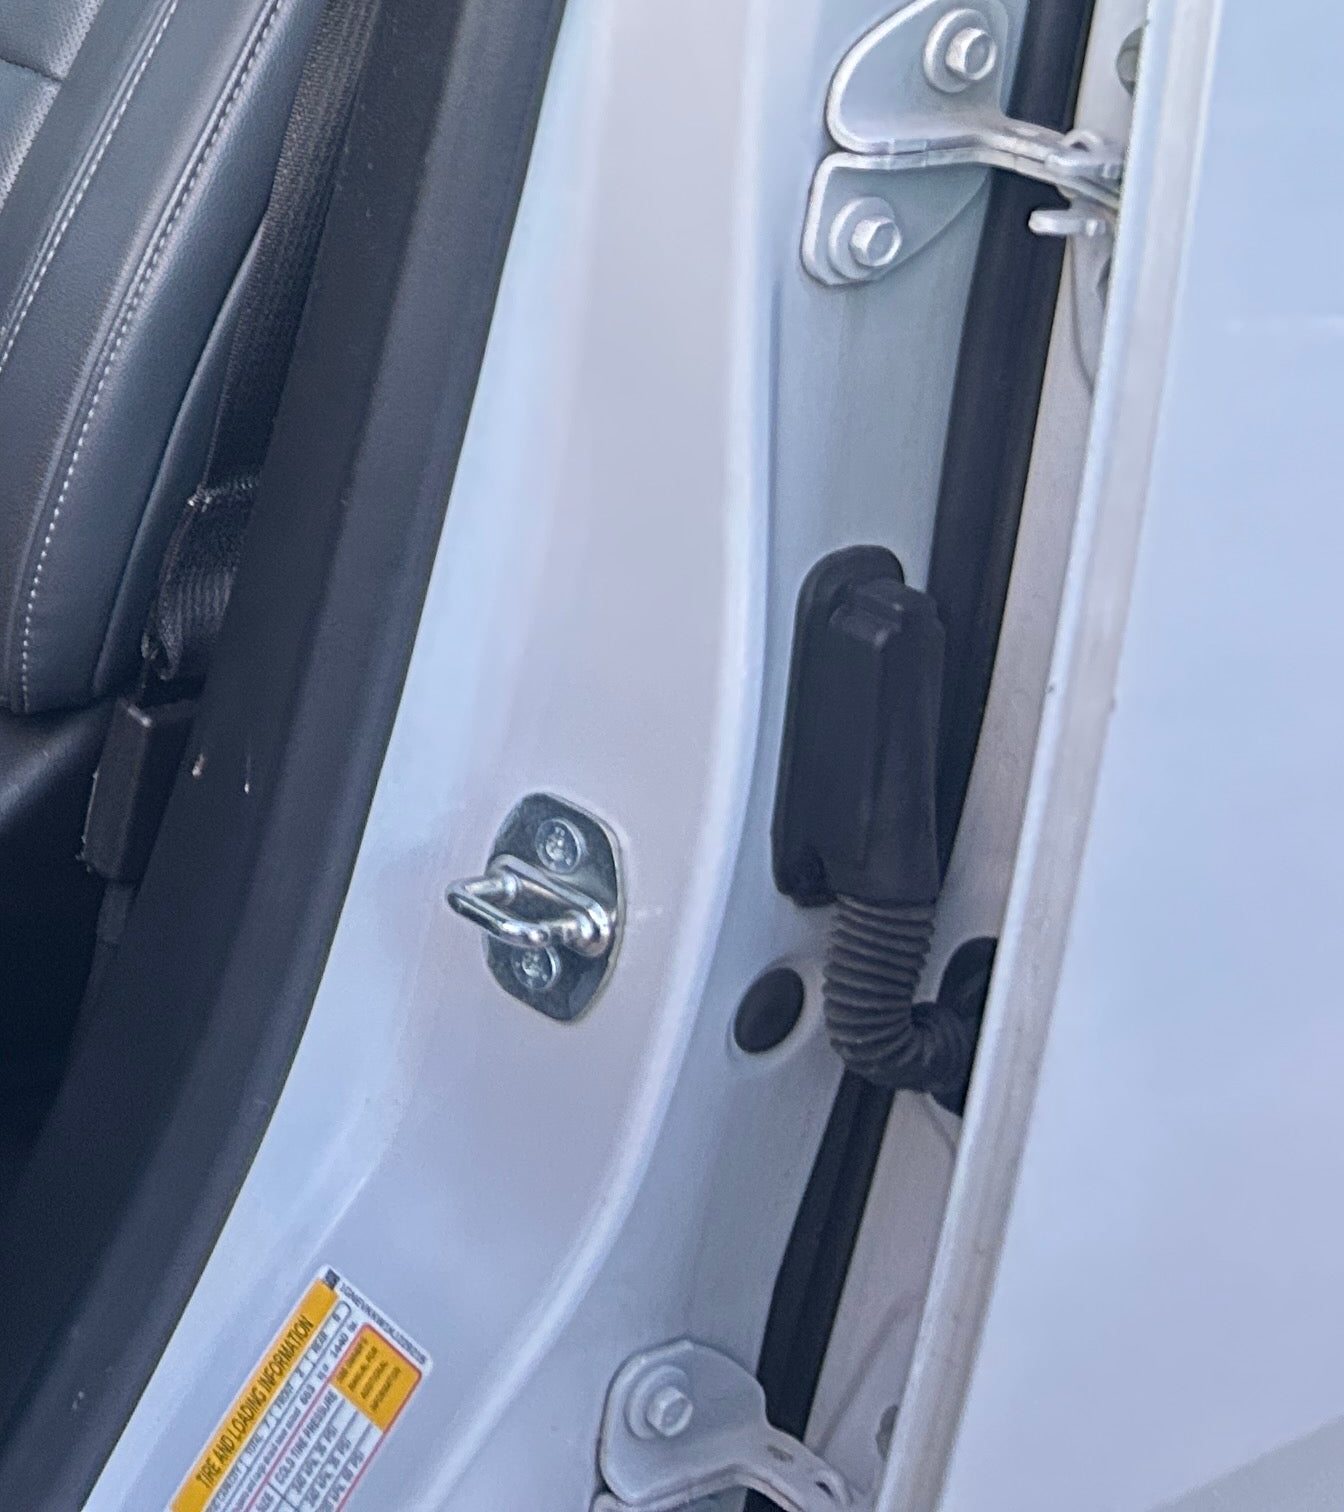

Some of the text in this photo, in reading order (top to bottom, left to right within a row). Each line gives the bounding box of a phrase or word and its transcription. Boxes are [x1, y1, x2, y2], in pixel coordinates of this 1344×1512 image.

[195, 1456, 221, 1487] TIRE
[212, 1433, 236, 1464] AND
[226, 1386, 267, 1440] LOADING
[257, 1314, 313, 1392] INFORMATION
